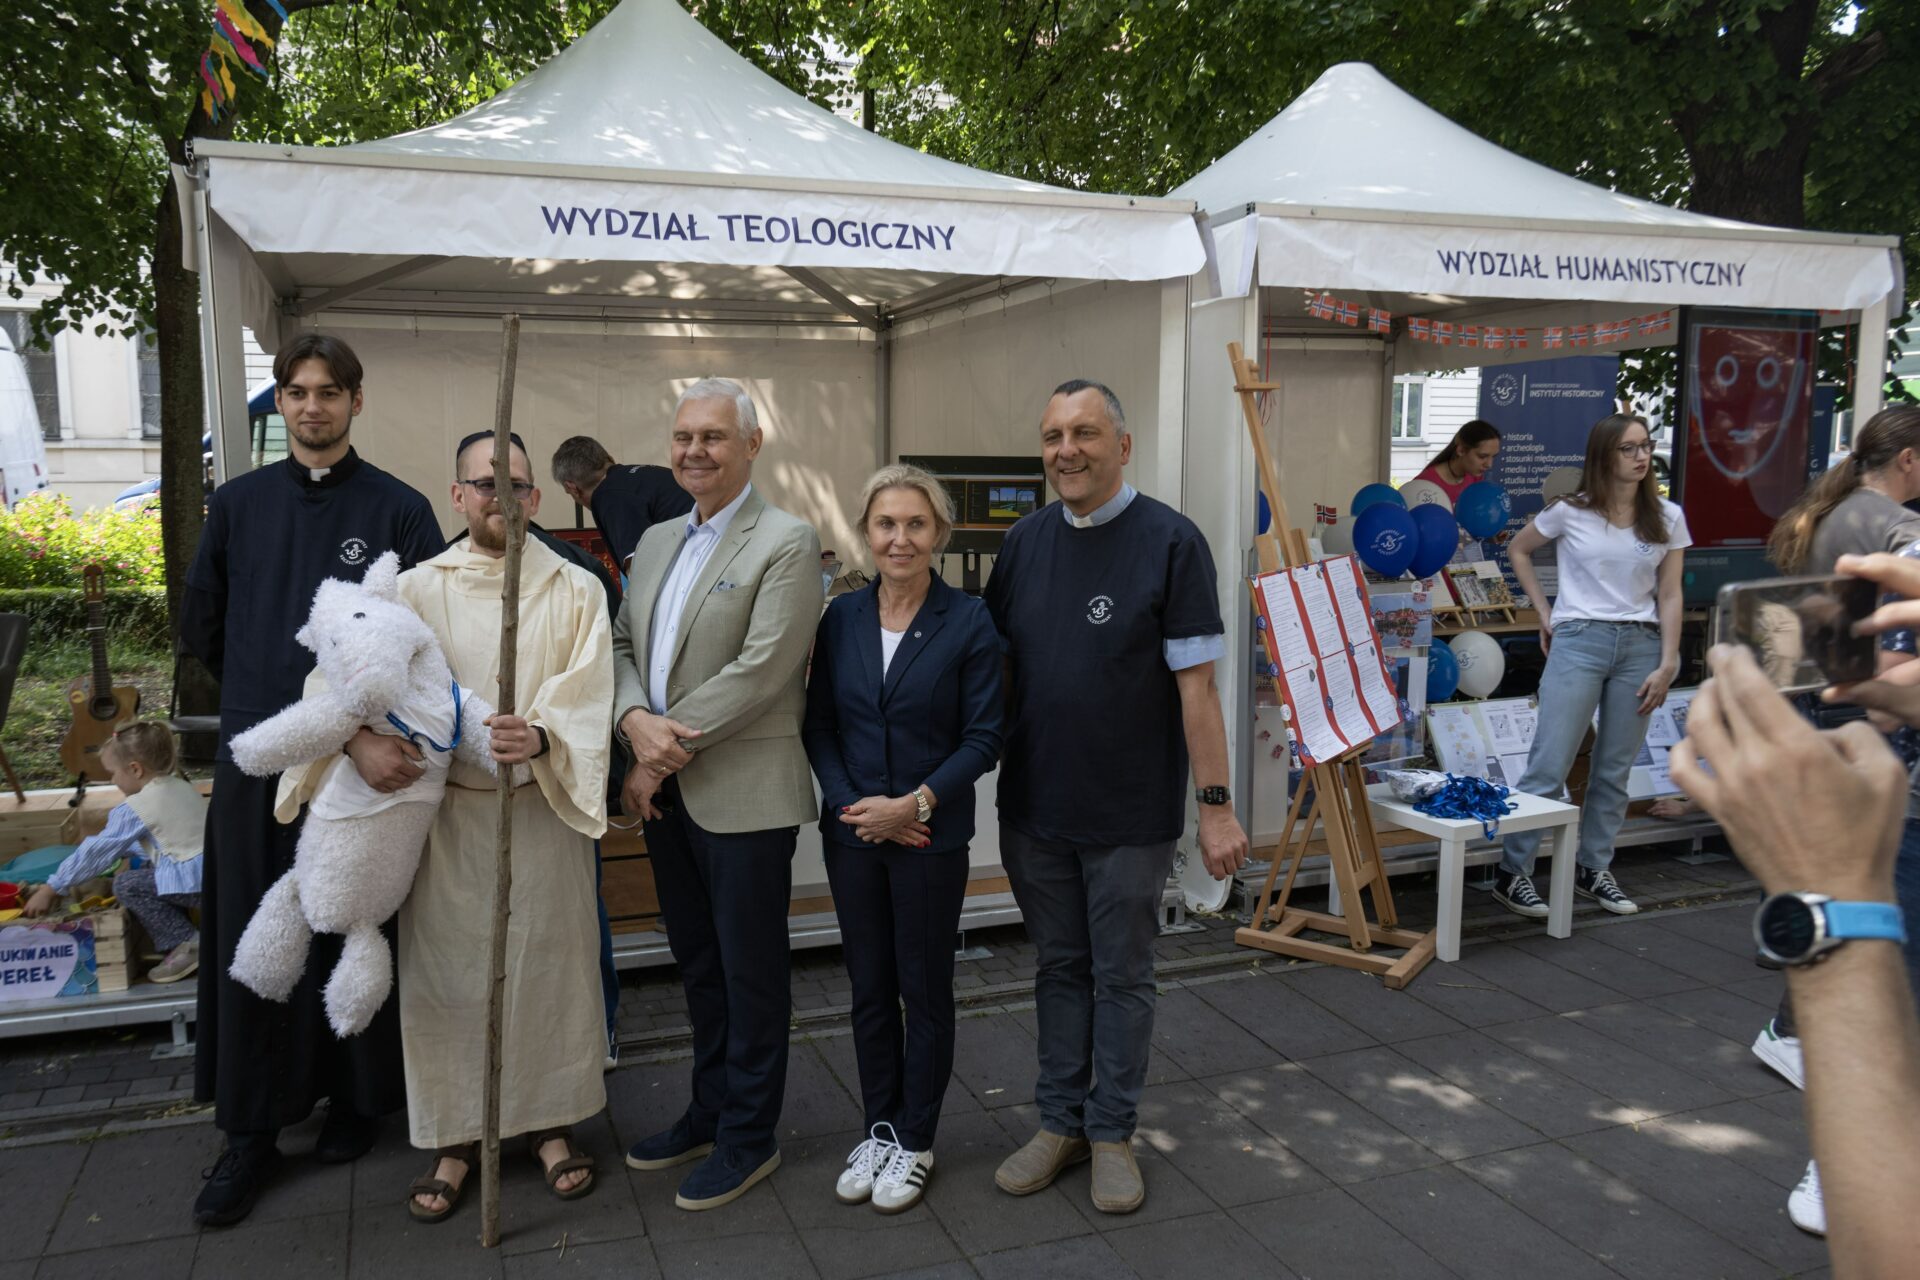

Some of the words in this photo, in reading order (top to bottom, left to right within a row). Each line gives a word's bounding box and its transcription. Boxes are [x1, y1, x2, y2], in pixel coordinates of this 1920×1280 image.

[541, 205, 710, 241] WYDZIAŁ
[717, 213, 956, 251] TEOLOGICZNY
[1437, 250, 1549, 279] WYDZIAŁ
[1556, 255, 1746, 287] HUMANISTYCZNY
[1529, 390, 1561, 398] INSTYTUT
[1562, 390, 1605, 398] HISTORYCZNY
[1507, 432, 1533, 441] historia
[1506, 443, 1544, 453] archeologia
[1505, 455, 1533, 463] stosunki
[1527, 476, 1538, 484] nad
[0, 944, 74, 962] UKIWANIE
